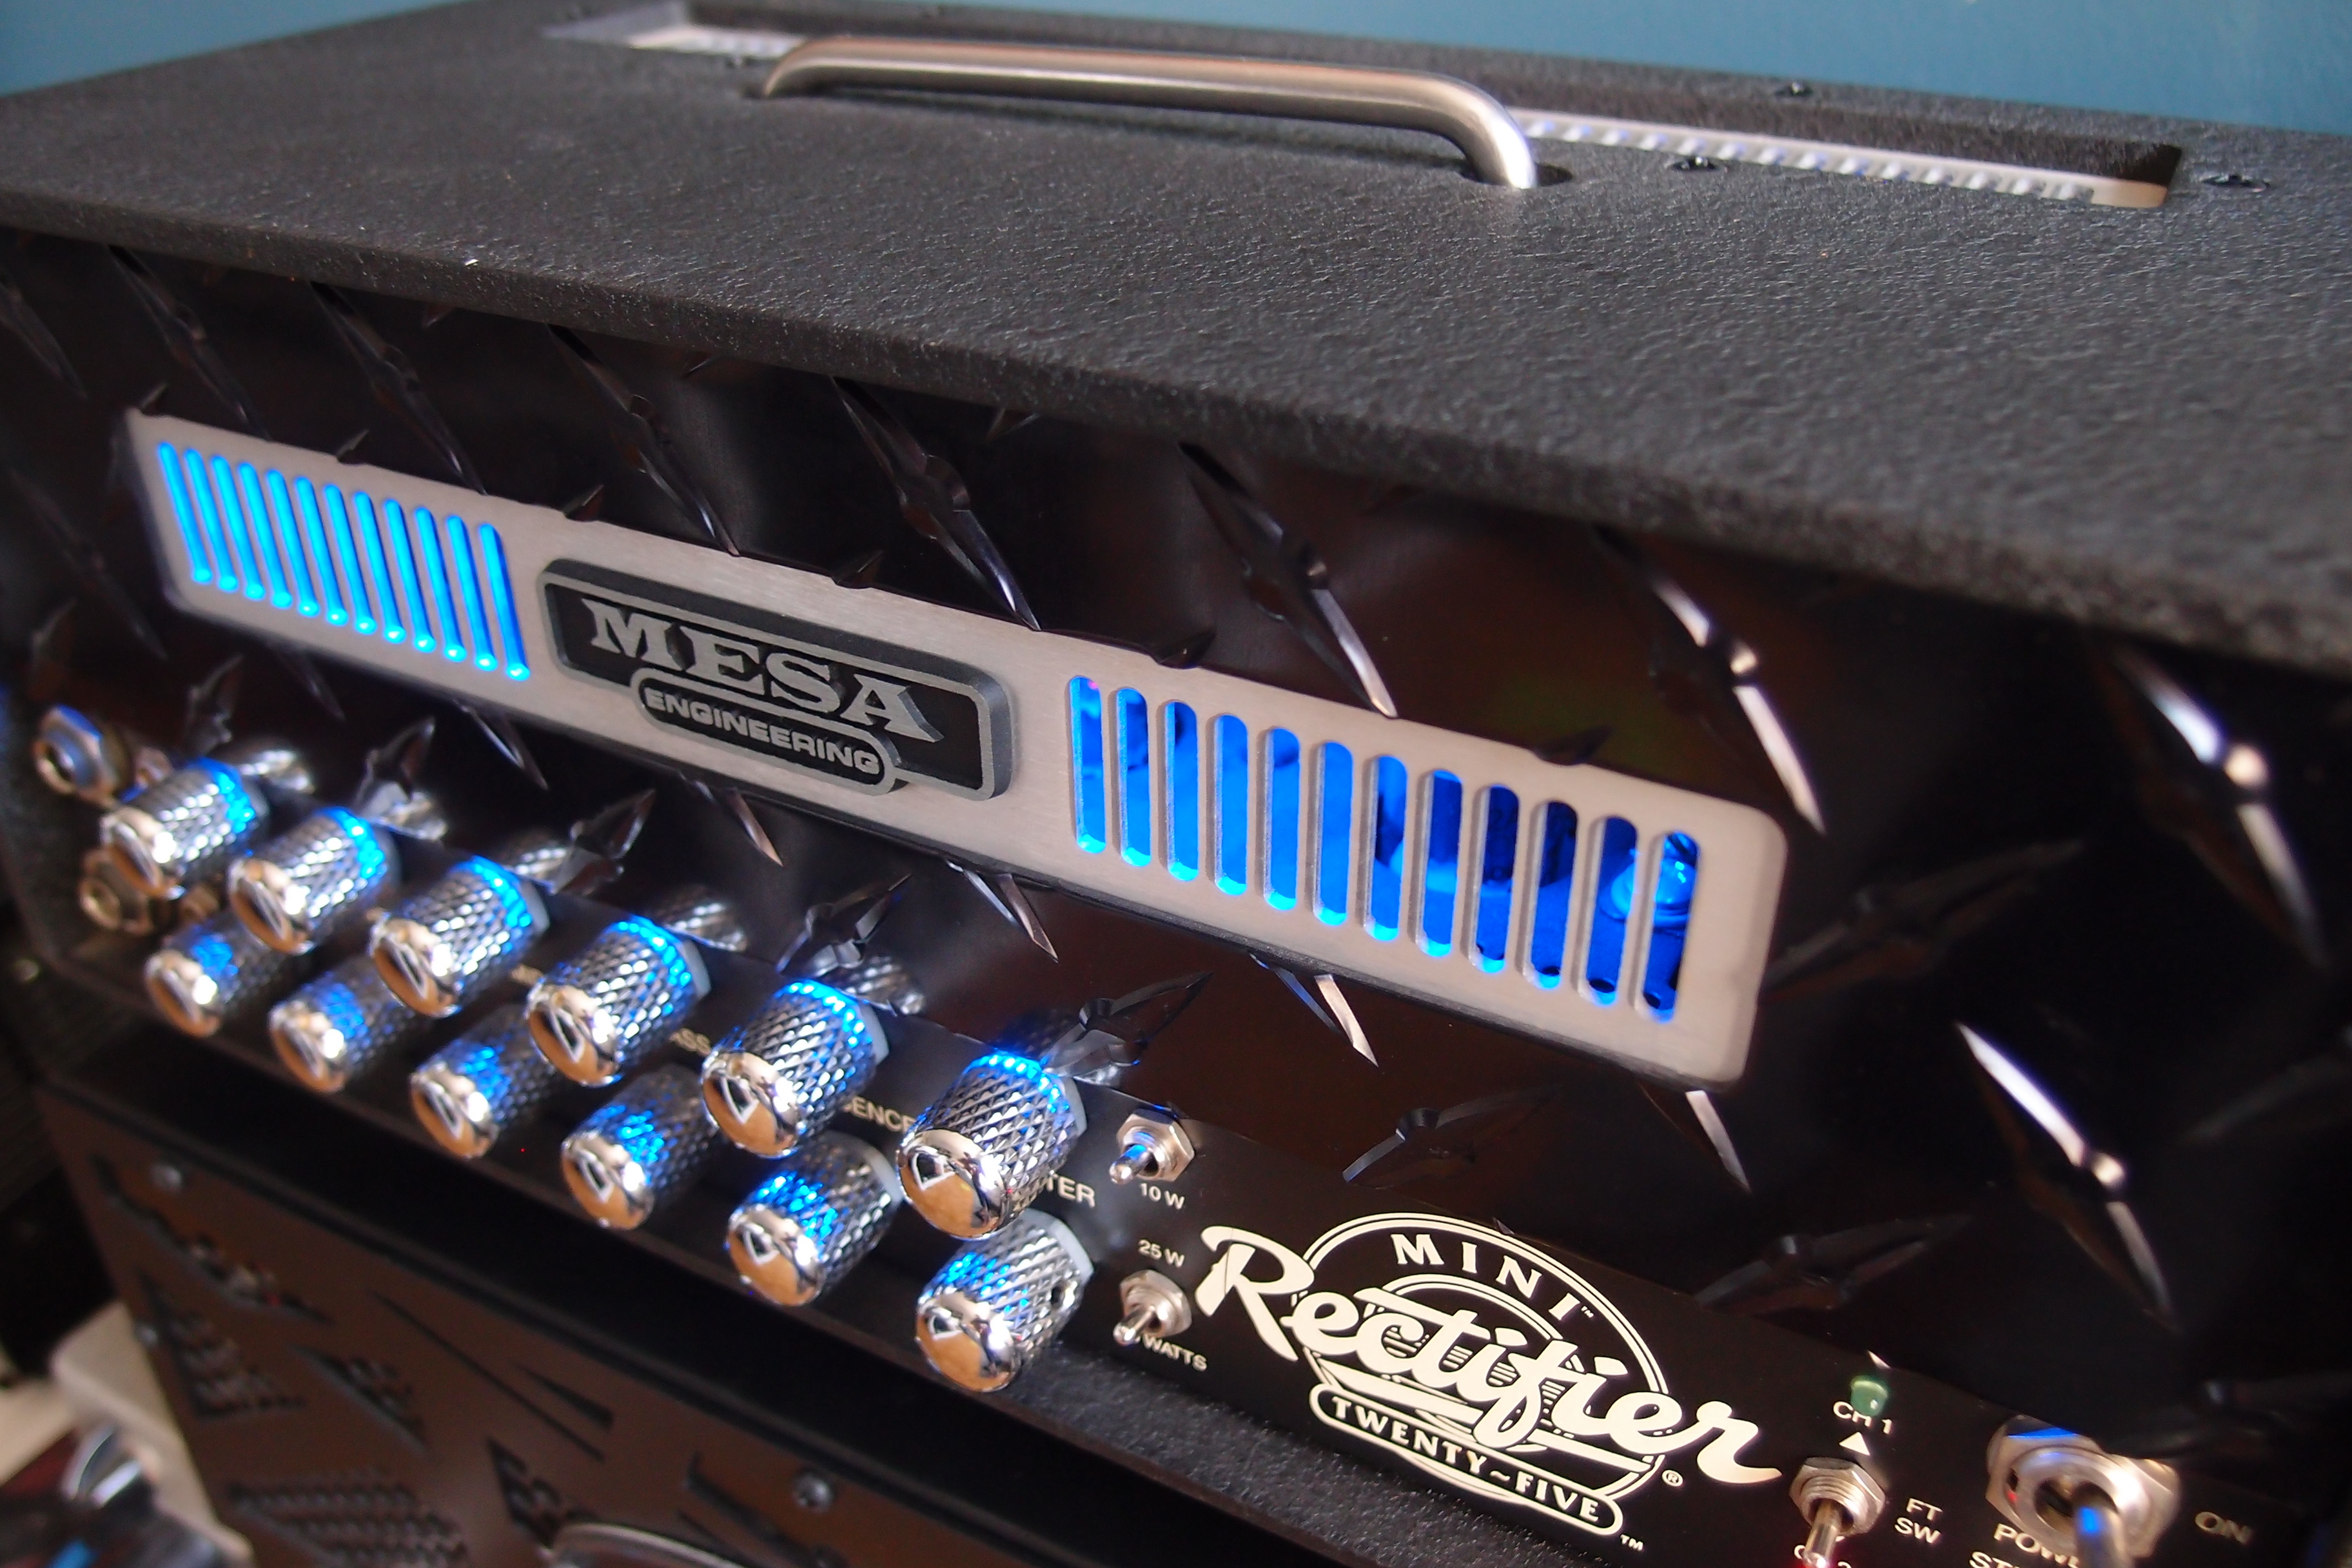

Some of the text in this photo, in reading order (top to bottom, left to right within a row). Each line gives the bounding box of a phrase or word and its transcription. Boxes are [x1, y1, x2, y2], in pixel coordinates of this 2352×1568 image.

[581, 598, 943, 742] MESA
[645, 689, 880, 774] ENGINEERING
[1046, 1173, 1095, 1208] TER
[1390, 1232, 1581, 1321] MINI
[1142, 1332, 1208, 1372] WATTS
[1194, 1225, 1782, 1485] Rectifier
[1906, 1497, 1943, 1521] FT
[2194, 1511, 2251, 1545] ON
[1894, 1516, 1942, 1544] SW
